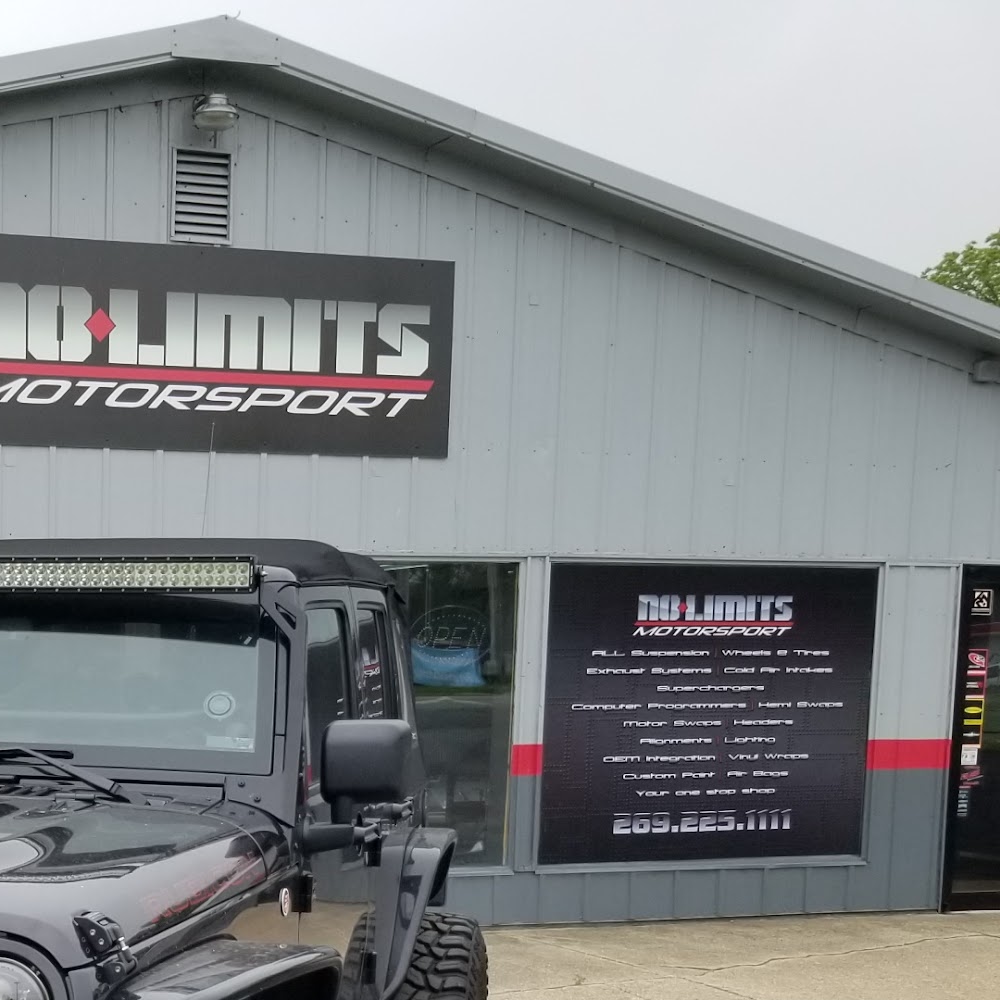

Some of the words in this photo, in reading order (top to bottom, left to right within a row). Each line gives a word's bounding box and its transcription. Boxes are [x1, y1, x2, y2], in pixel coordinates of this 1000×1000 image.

[108, 288, 431, 377] LIMITS
[638, 595, 680, 620] NO
[685, 596, 792, 621] LIMITS
[633, 627, 791, 636] MOTORSPORT
[417, 626, 487, 649] OPEN
[631, 649, 709, 657] Suspension
[722, 649, 771, 657] Wheels
[587, 667, 645, 675] Exhaust
[651, 667, 711, 675] Systems
[724, 666, 755, 674] Cold
[760, 666, 780, 674] Air
[786, 666, 832, 674] Intakes
[657, 684, 764, 692] Superchargers
[572, 703, 641, 711] Computer
[648, 702, 746, 710] Programmers
[624, 720, 667, 728] Motor
[674, 719, 721, 727] Swaps
[640, 737, 712, 745] Alignments
[603, 755, 640, 763] OEM
[646, 754, 715, 762] Integration
[682, 771, 715, 779] Paint
[706, 788, 736, 796] stop
[613, 809, 791, 834] 269.225.1111
